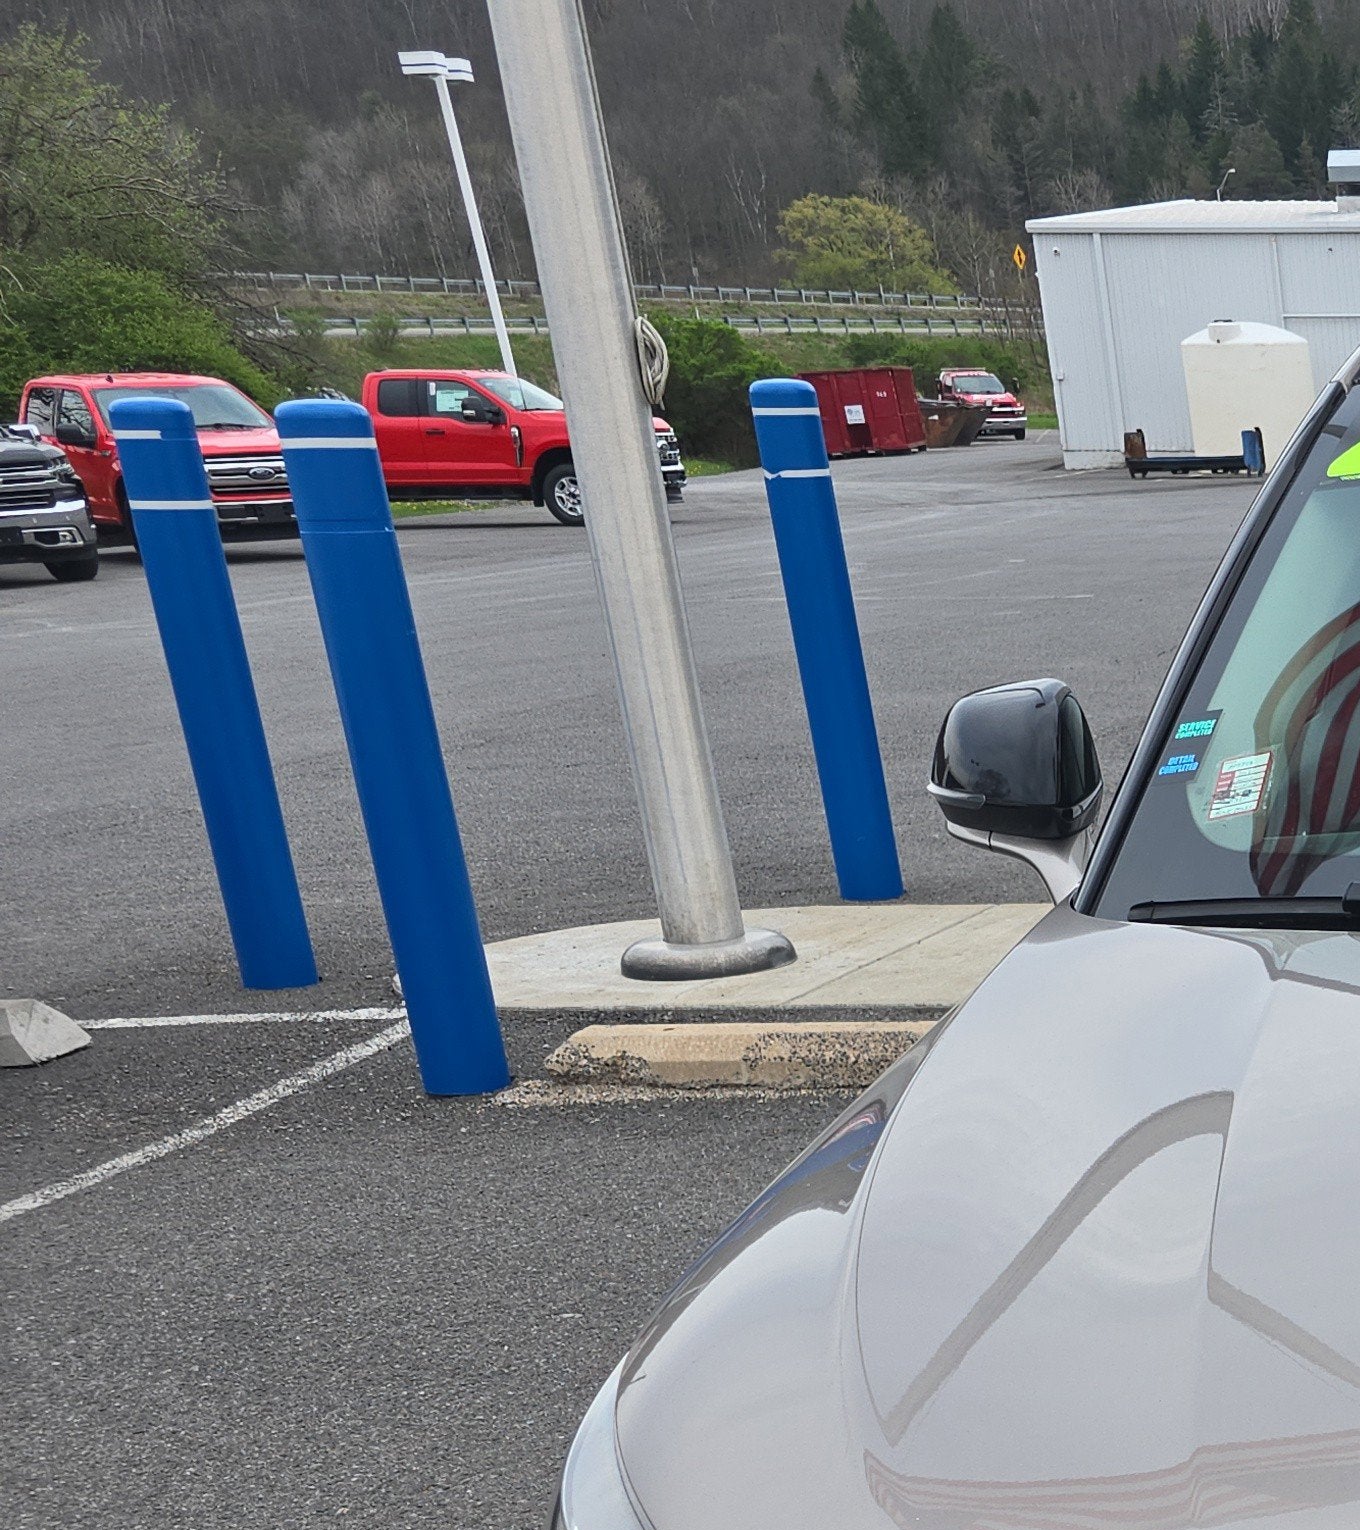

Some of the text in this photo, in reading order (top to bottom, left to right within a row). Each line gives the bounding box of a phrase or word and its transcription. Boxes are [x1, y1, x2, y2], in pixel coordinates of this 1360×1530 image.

[1178, 719, 1217, 733] SERVICE
[1175, 728, 1213, 740] COMPLETED
[1168, 754, 1196, 766] DETAIL
[1158, 762, 1200, 776] COMPLETED
